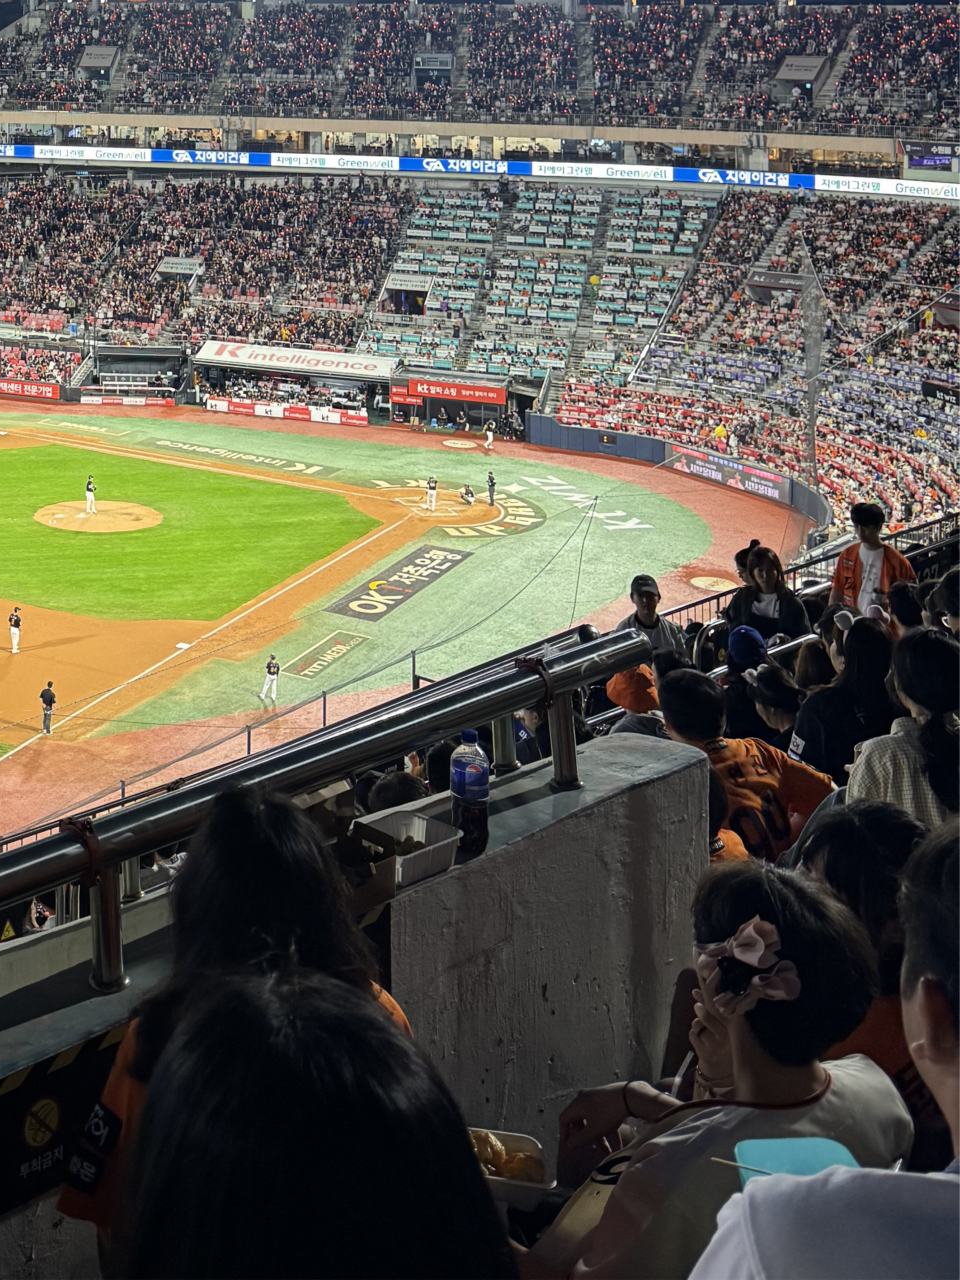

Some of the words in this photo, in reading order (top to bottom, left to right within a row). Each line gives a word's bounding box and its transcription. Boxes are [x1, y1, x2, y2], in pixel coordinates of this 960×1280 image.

[195, 151, 249, 164] 지에이건설
[448, 159, 508, 174] 지에이건설
[726, 169, 789, 186] 지에이건설
[213, 343, 246, 359] K
[247, 349, 378, 372] intelligence
[23, 384, 52, 397] 전문기업
[417, 383, 429, 393] kt
[430, 385, 443, 395] 알파
[443, 387, 457, 397] 쇼핑
[210, 402, 218, 411] kt
[264, 407, 273, 416] kt
[321, 413, 330, 422] kt
[155, 438, 287, 468] intelligence
[388, 549, 463, 586] 저축은행
